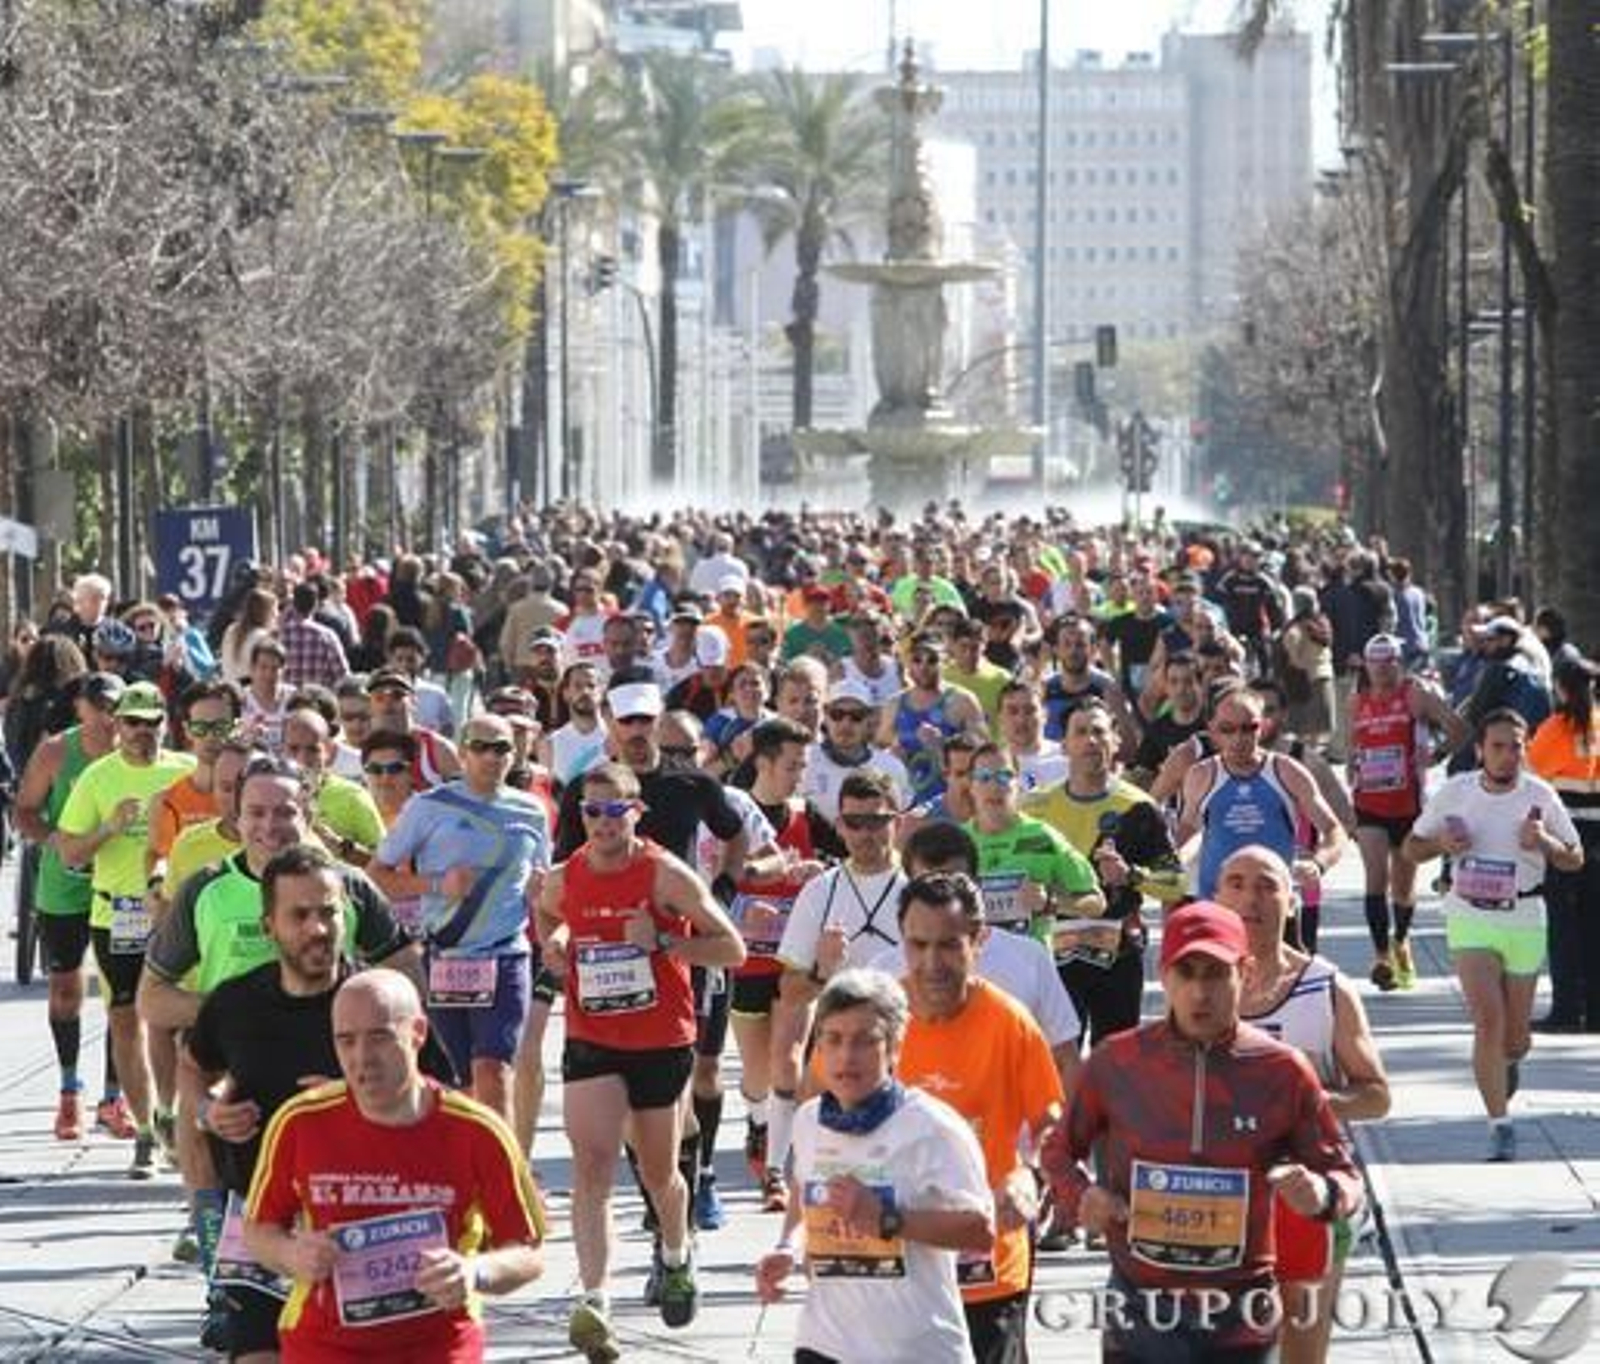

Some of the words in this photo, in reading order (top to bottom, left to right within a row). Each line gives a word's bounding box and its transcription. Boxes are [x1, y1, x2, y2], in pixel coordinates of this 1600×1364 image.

[190, 517, 220, 540] KM
[179, 546, 231, 599] 37
[1170, 1174, 1233, 1191] ZURICH
[369, 1218, 431, 1242] ZURICH
[1163, 1207, 1217, 1231] 4691
[367, 1252, 422, 1280] 6242
